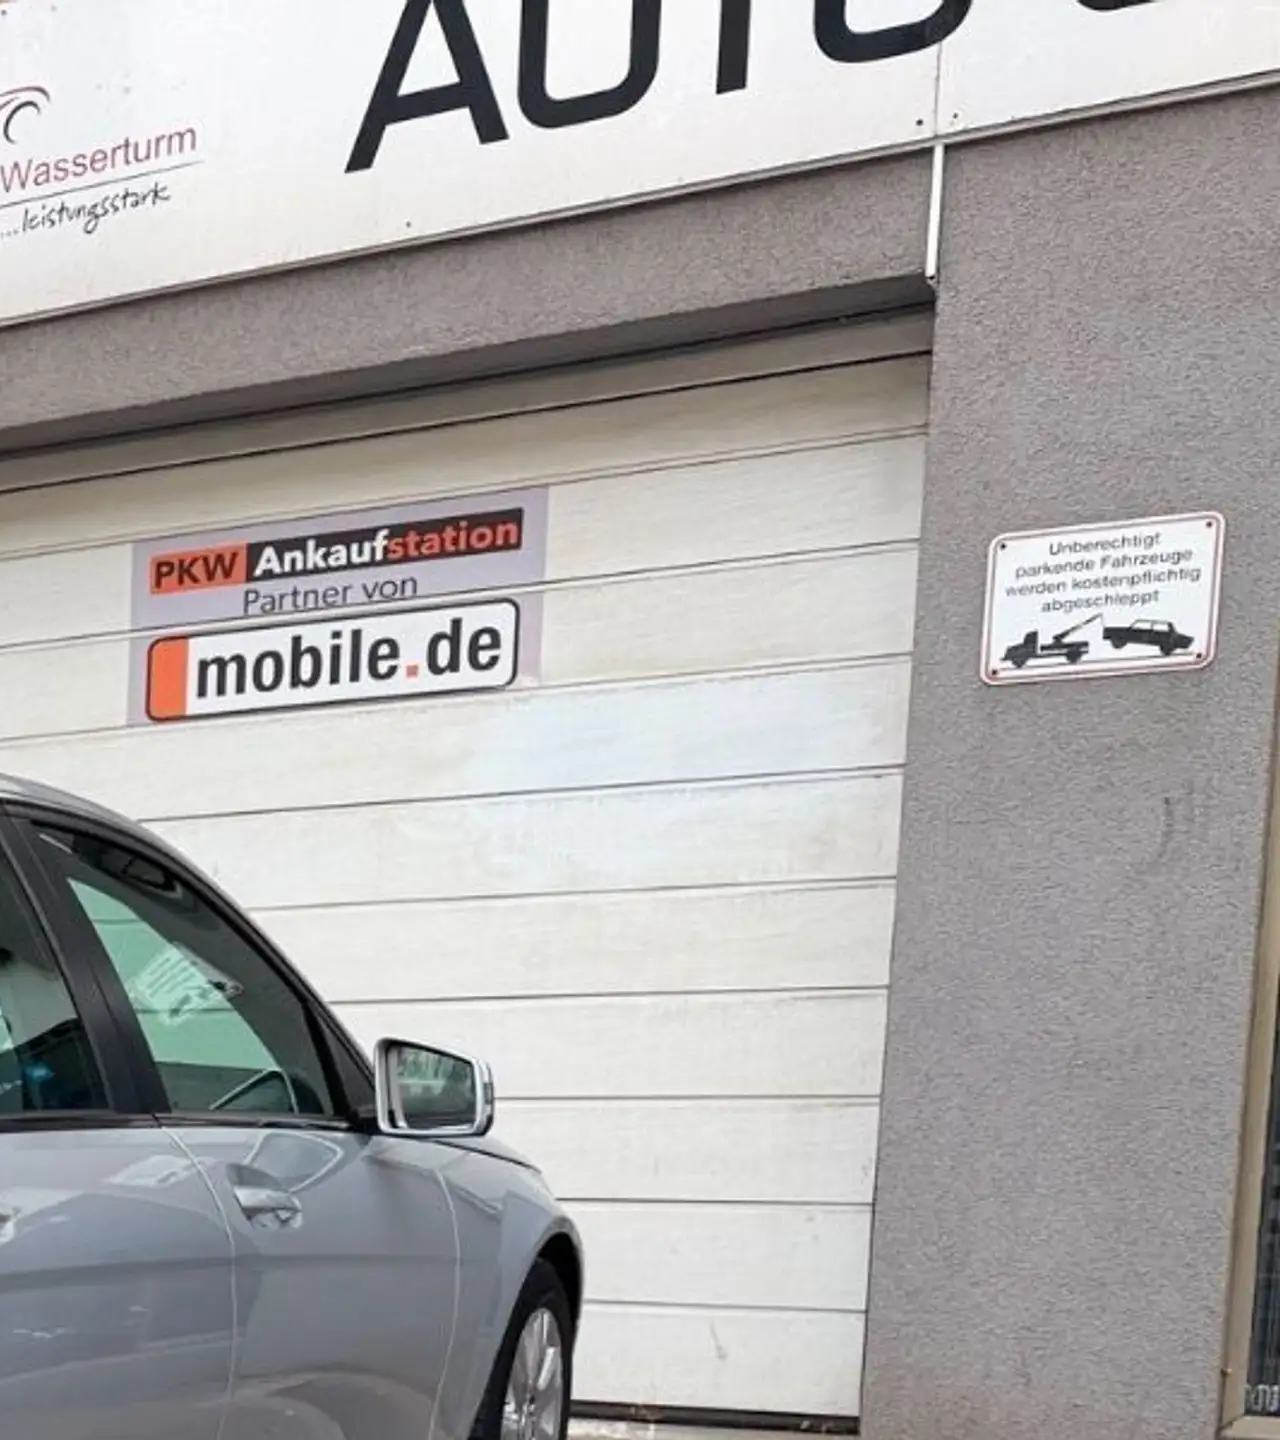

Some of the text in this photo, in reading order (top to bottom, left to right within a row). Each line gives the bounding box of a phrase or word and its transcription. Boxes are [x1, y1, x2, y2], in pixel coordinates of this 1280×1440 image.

[0, 127, 197, 194] Wasserturm
[154, 520, 520, 590] PKW Ankaufstation
[1049, 531, 1162, 557] Unberechtigt
[1005, 567, 1203, 598] werden kostenpflichtig
[1015, 548, 1195, 581] parkende Fahrzeuge
[243, 575, 419, 615] Partner von
[1041, 589, 1161, 613] abgeschleppt
[197, 617, 503, 699] mobile.de
